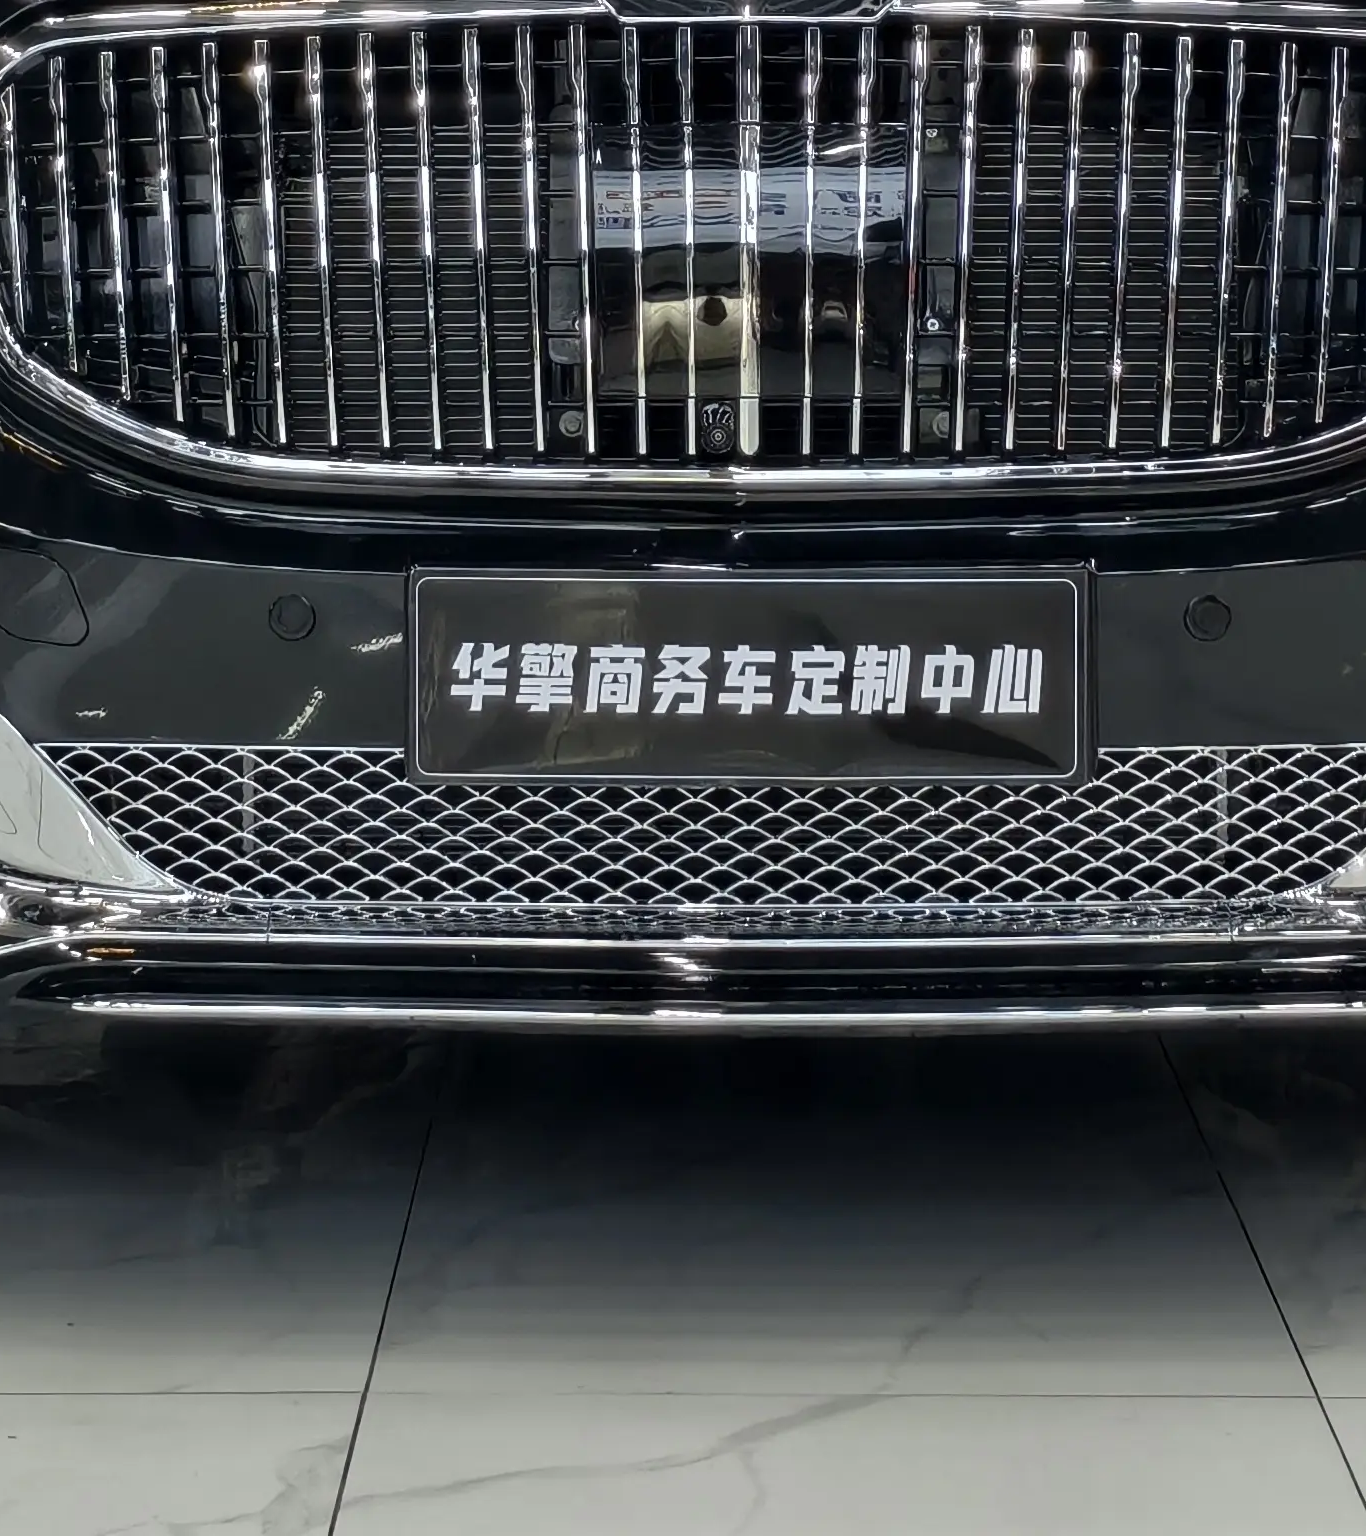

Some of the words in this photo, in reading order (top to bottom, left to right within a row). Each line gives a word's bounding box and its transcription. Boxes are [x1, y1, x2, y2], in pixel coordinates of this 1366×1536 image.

[448, 641, 1045, 717] 华擎商务车定制中心
